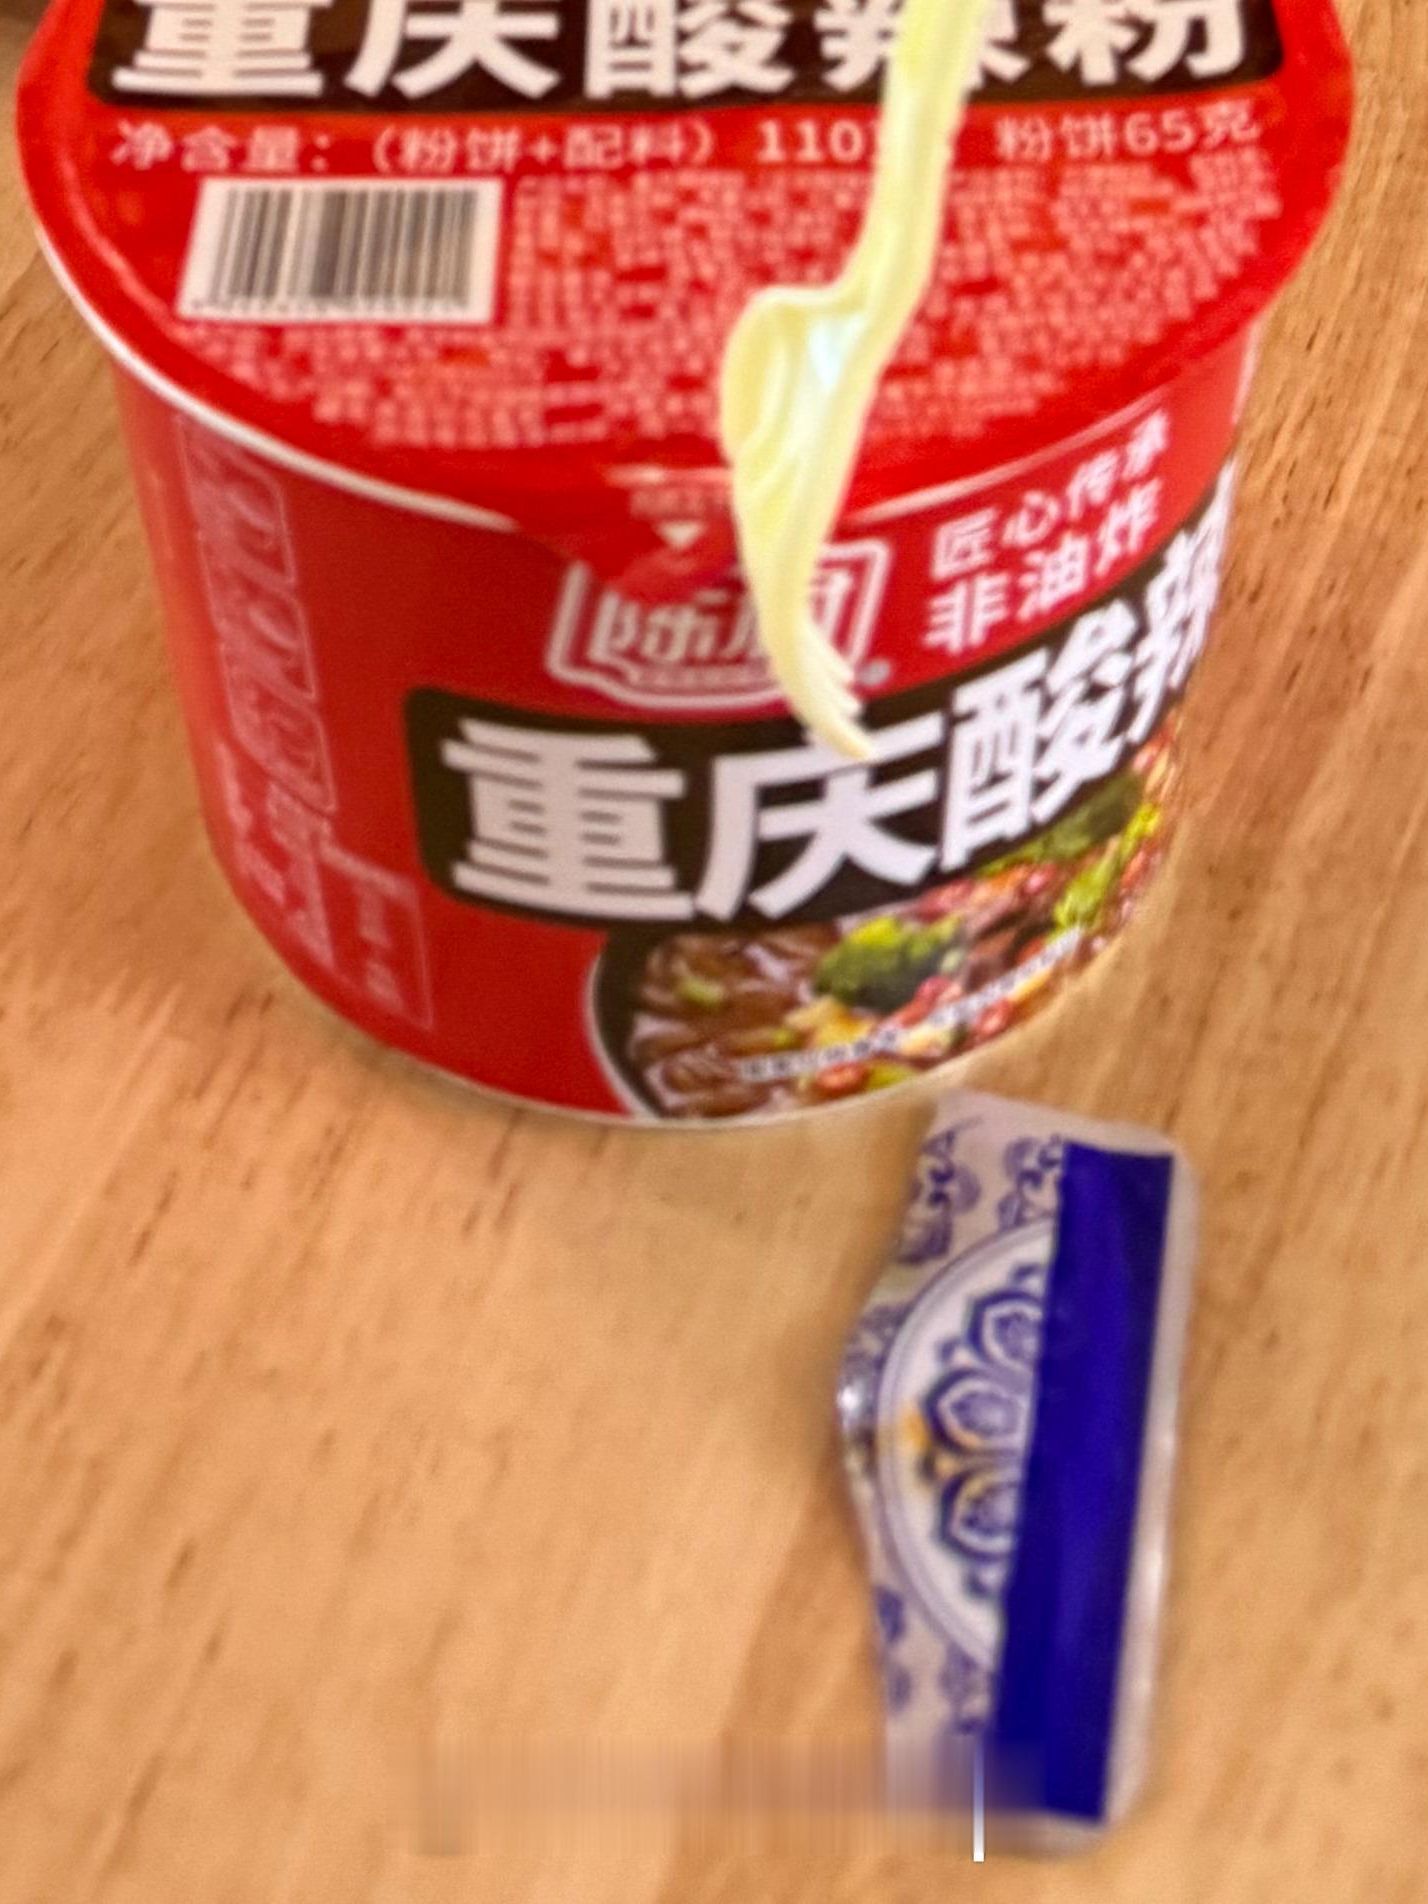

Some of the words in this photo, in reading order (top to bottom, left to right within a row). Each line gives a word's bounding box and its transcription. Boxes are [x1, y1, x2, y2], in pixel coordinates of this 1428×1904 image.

[922, 479, 1161, 653] 非油炸
[932, 410, 1169, 573] 匠心传承
